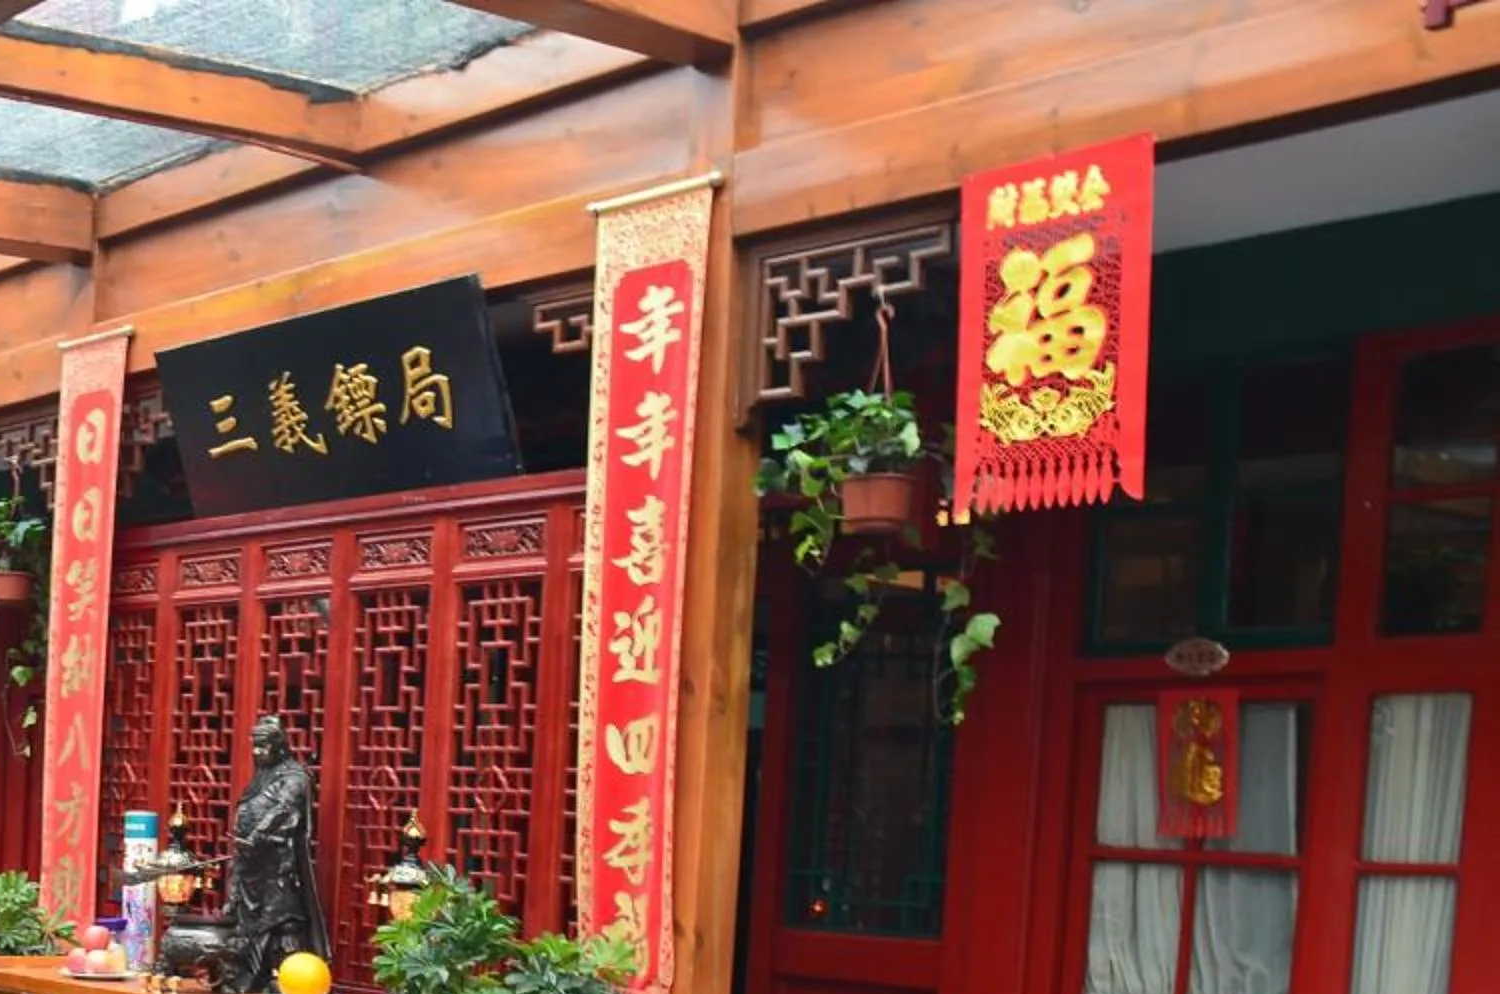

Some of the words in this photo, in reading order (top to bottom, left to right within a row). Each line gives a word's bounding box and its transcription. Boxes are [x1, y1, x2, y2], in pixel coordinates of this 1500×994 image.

[986, 232, 1108, 386] 福
[208, 346, 452, 458] 三義鏢局
